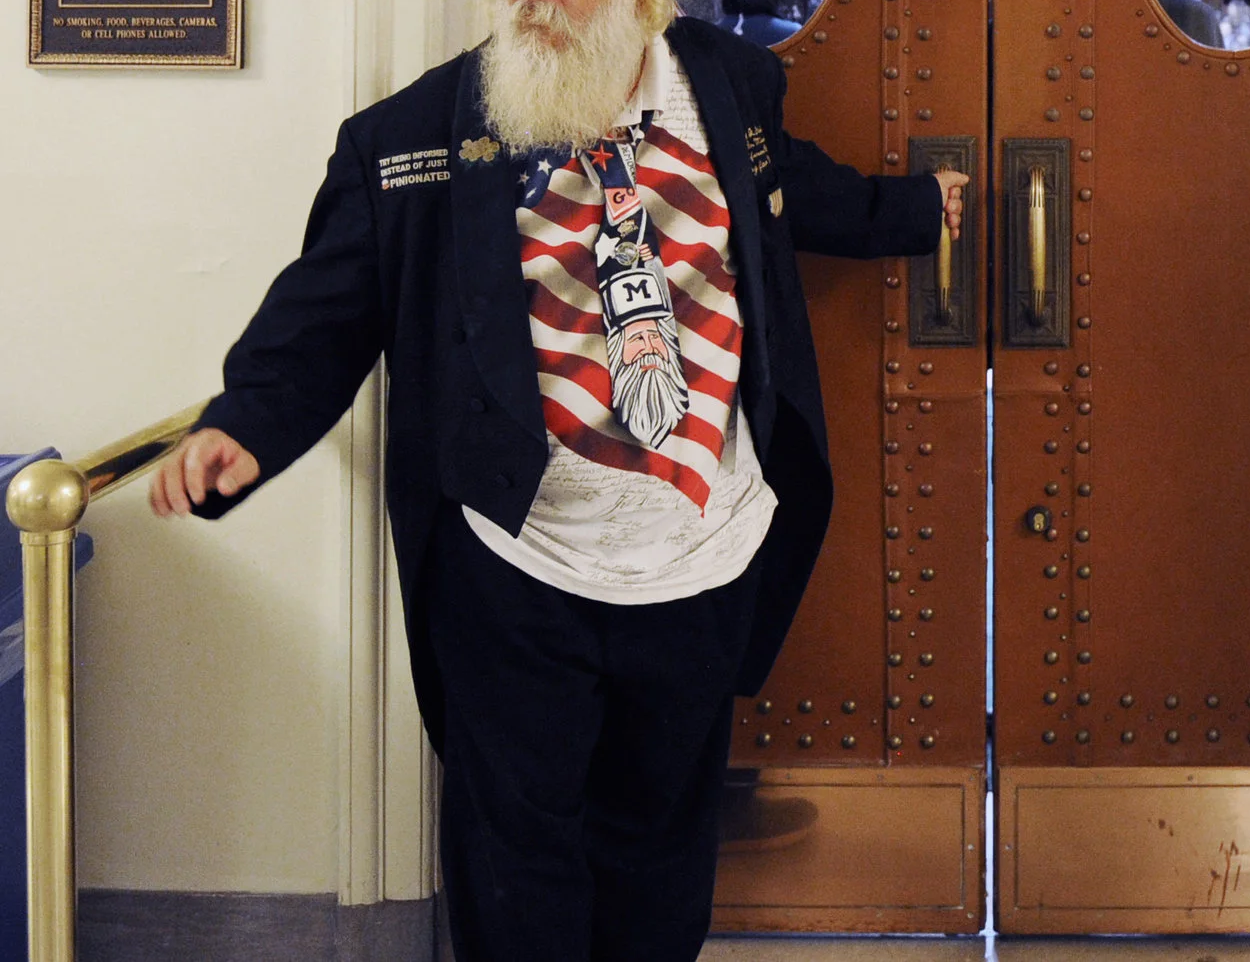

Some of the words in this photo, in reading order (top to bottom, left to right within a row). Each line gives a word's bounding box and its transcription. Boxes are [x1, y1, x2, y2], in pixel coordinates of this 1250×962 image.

[53, 18, 64, 27] NO
[81, 30, 93, 38] OR
[94, 30, 113, 38] CELL
[116, 30, 146, 39] PHONES
[412, 161, 424, 170] OF
[425, 159, 448, 168] JUST
[622, 279, 652, 302] M
